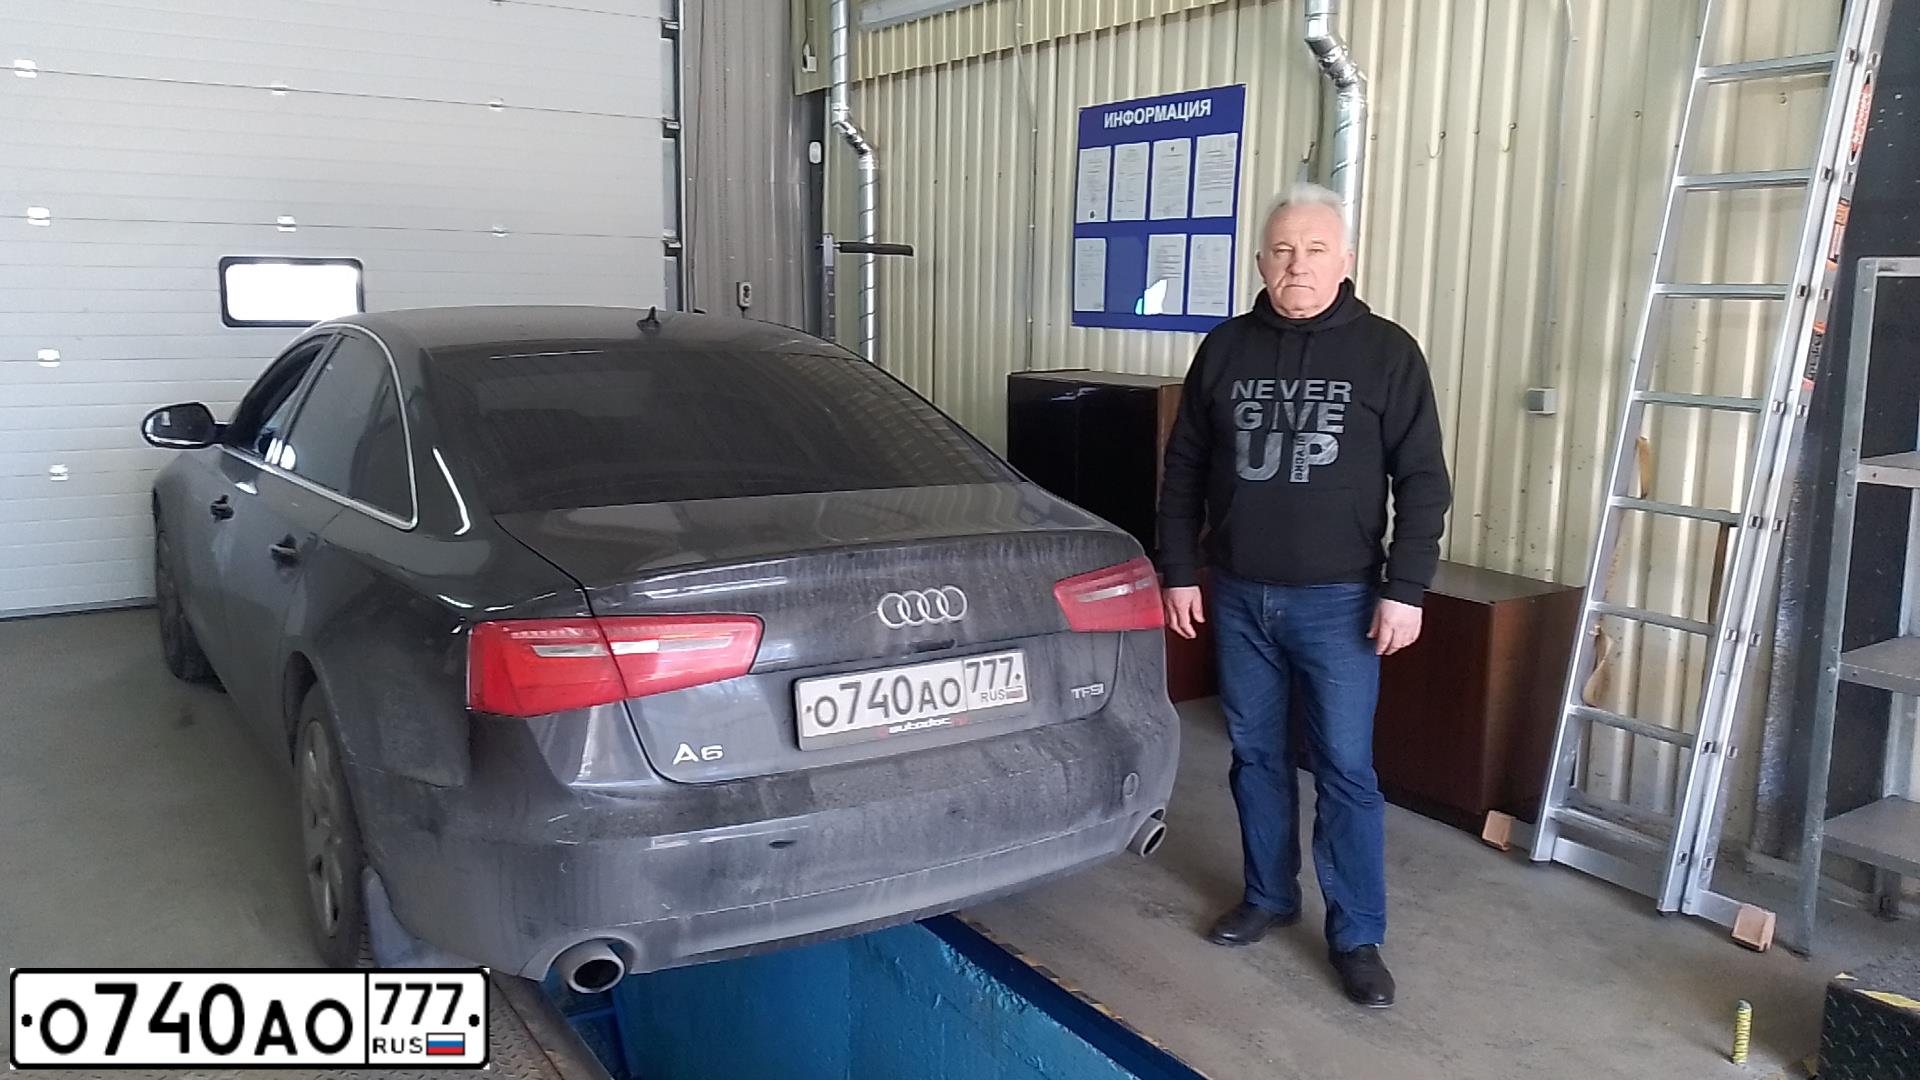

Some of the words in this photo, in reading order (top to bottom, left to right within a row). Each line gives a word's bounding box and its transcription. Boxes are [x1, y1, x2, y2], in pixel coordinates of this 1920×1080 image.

[1103, 98, 1212, 129] ИНФОРМАЦИЯ
[1230, 379, 1353, 403] NEVER
[1233, 401, 1346, 434] GIVE
[1235, 430, 1340, 483] UP
[966, 656, 1015, 694] 777
[980, 688, 1005, 702] RUS
[1070, 683, 1105, 699] TFSI
[672, 743, 724, 765] A6
